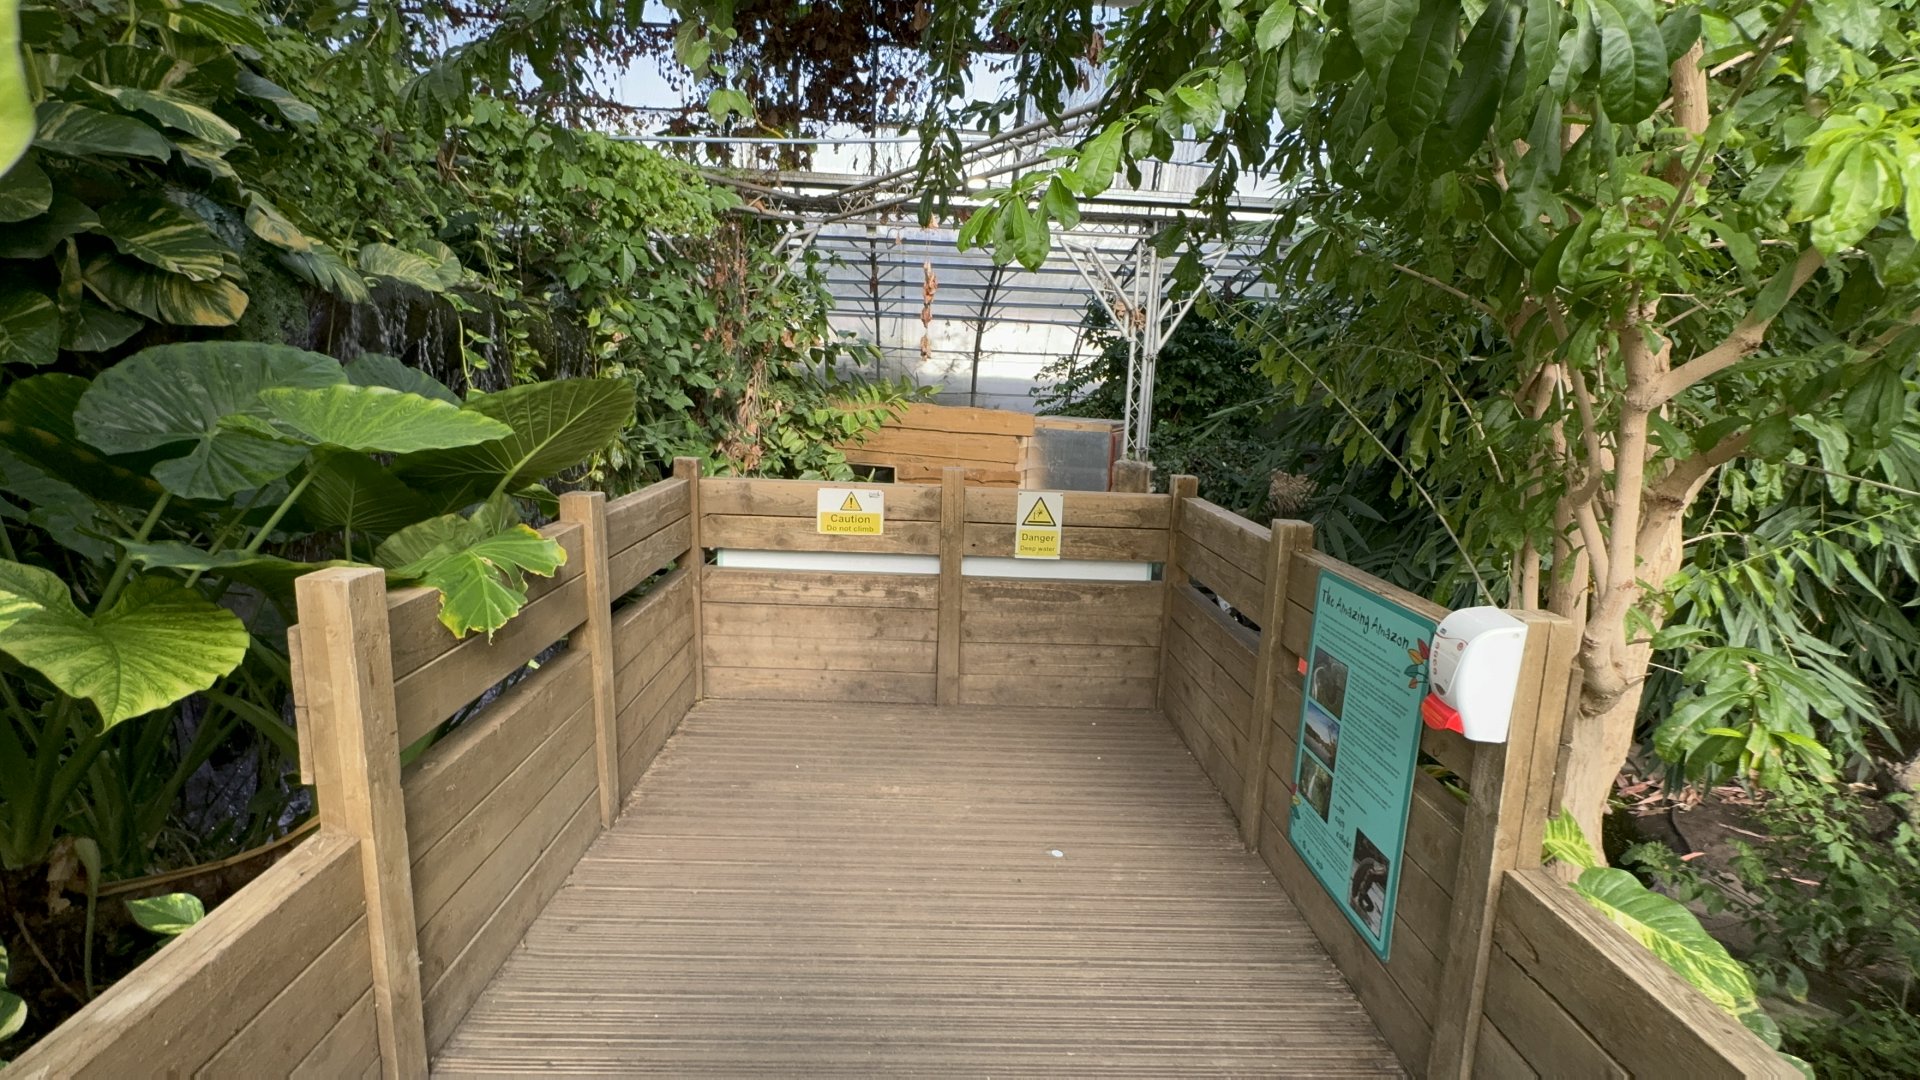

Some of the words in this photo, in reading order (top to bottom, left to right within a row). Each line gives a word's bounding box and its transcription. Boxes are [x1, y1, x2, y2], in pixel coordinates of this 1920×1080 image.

[831, 514, 870, 523] Caution
[1022, 533, 1055, 543] Danger
[1322, 587, 1335, 607] The
[1335, 598, 1370, 634] Amazing
[1371, 617, 1409, 649] Amazon
